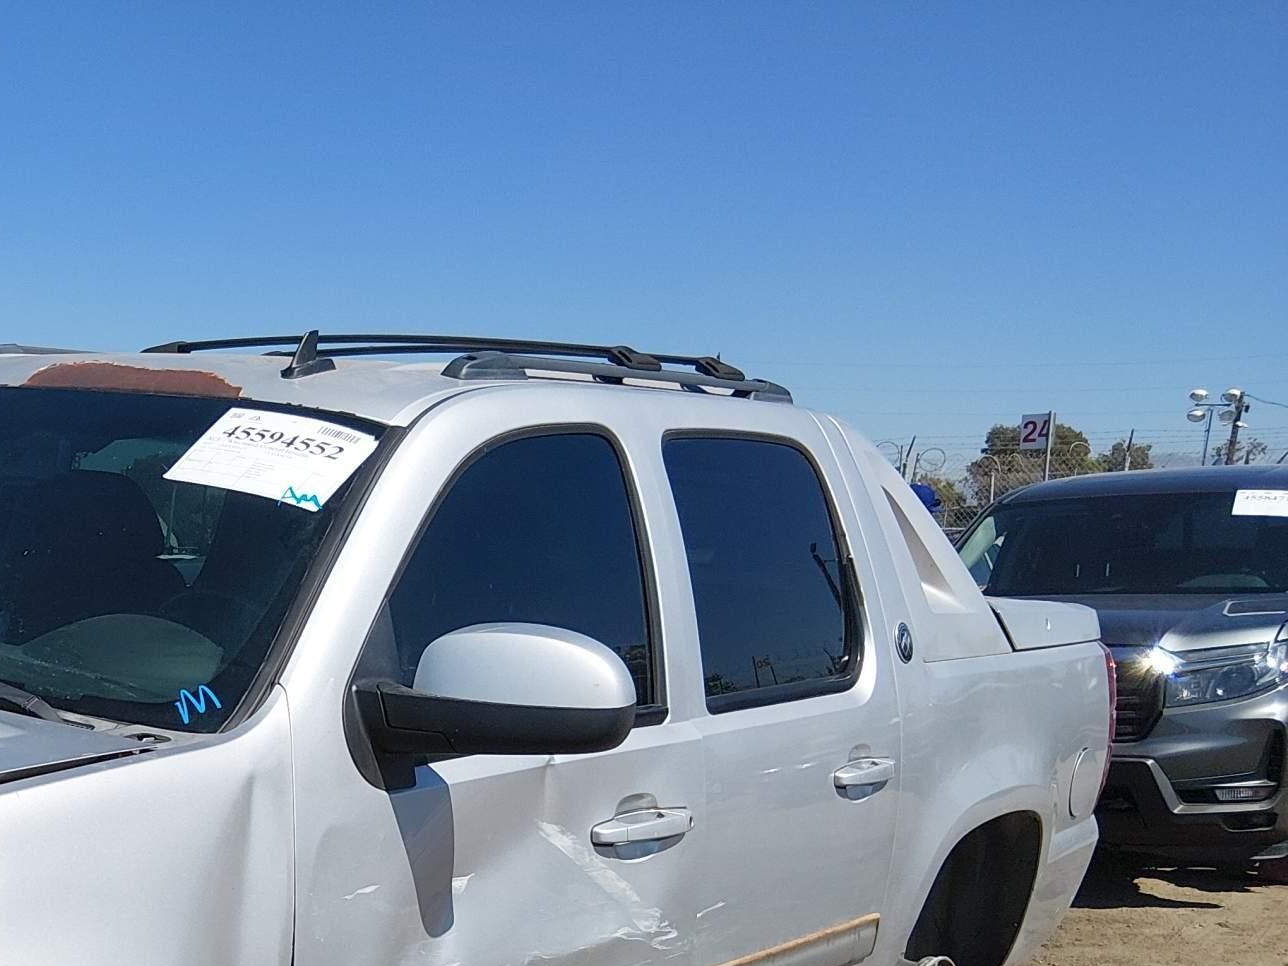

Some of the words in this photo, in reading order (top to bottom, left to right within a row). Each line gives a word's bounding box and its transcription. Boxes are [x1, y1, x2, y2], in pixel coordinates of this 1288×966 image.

[223, 424, 345, 461] 45594552
[1022, 419, 1049, 443] 24
[174, 684, 222, 725] M
